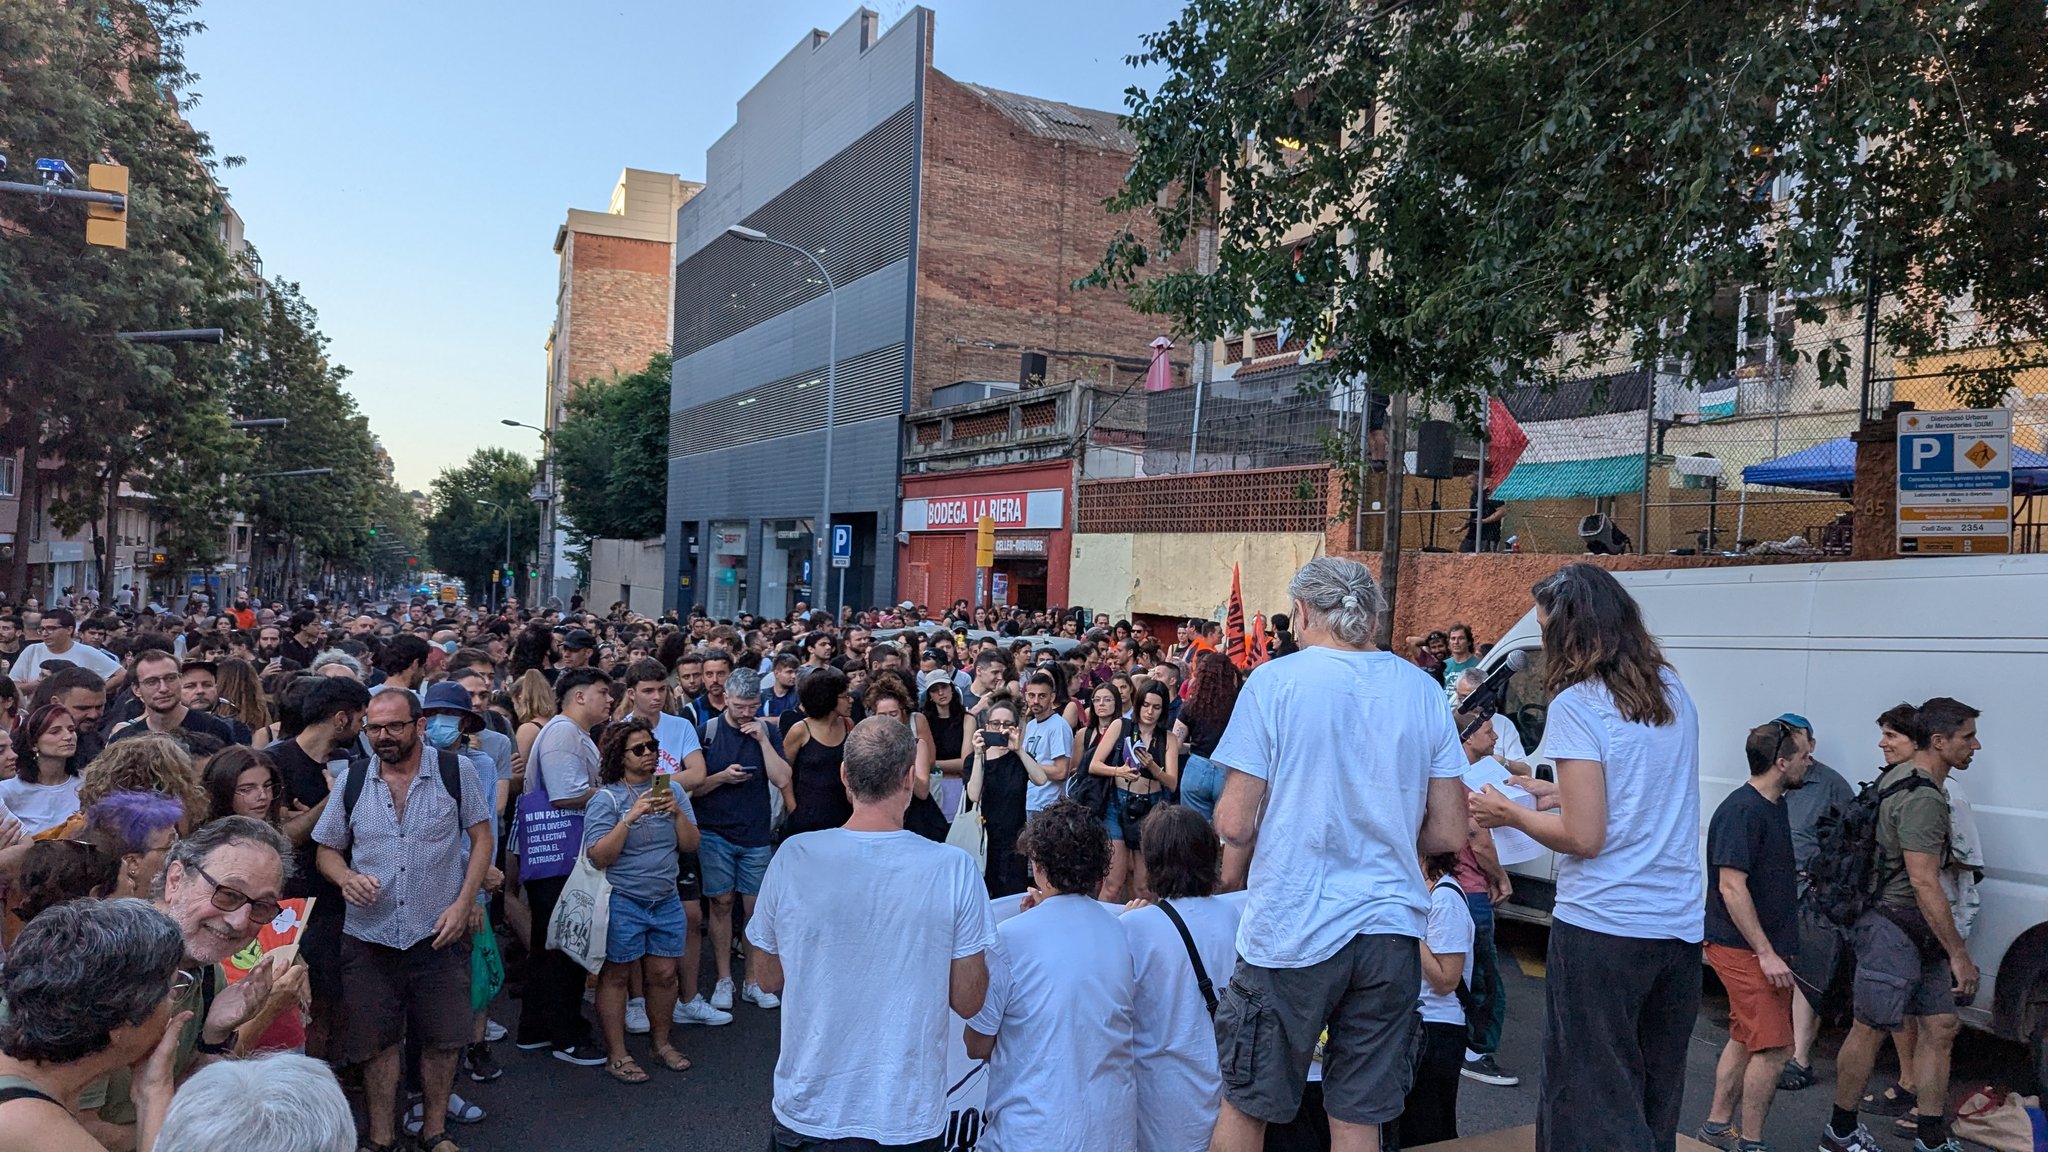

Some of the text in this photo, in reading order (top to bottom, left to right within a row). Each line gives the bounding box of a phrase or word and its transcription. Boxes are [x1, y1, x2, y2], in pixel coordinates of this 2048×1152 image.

[1912, 437, 1941, 470] P
[928, 498, 1022, 524] BODEGA LA RIERA
[835, 528, 847, 554] P
[525, 812, 534, 822] NI
[534, 811, 545, 821] UN
[545, 809, 560, 820] PAS
[526, 820, 572, 833] LLUITA DIVERSA
[527, 843, 560, 855] CONTRA EL
[528, 853, 565, 865] PATRIARCAT
